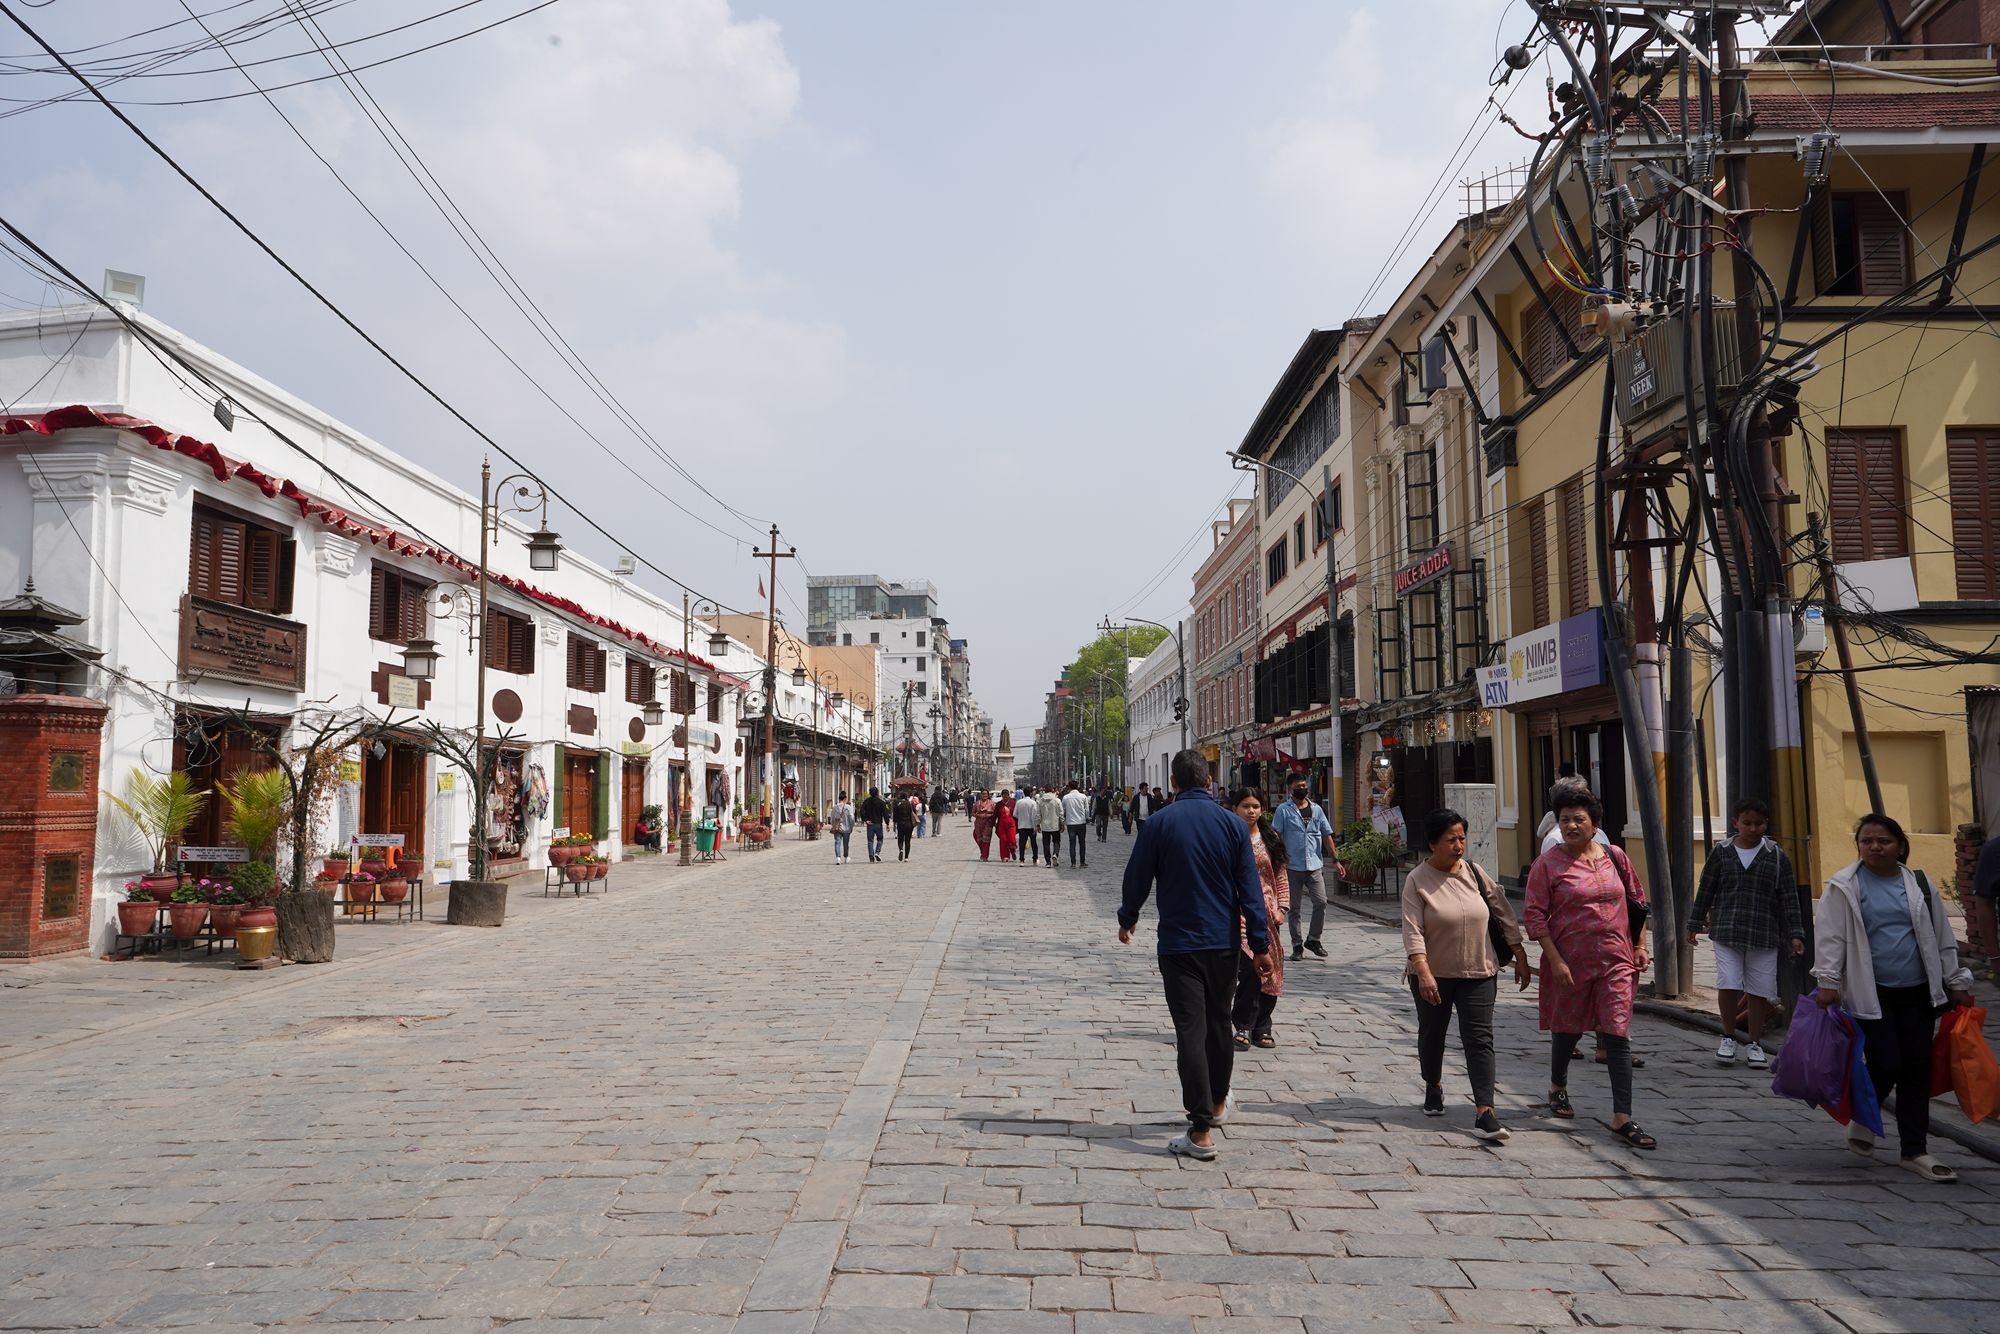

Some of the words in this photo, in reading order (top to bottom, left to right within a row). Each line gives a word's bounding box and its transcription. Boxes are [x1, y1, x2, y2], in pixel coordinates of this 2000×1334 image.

[1630, 374, 1653, 400] NEEK
[1394, 567, 1418, 592] JUICE
[1419, 548, 1449, 579] ADDA
[1525, 638, 1557, 670] NIMB
[1493, 667, 1508, 679] NIMB
